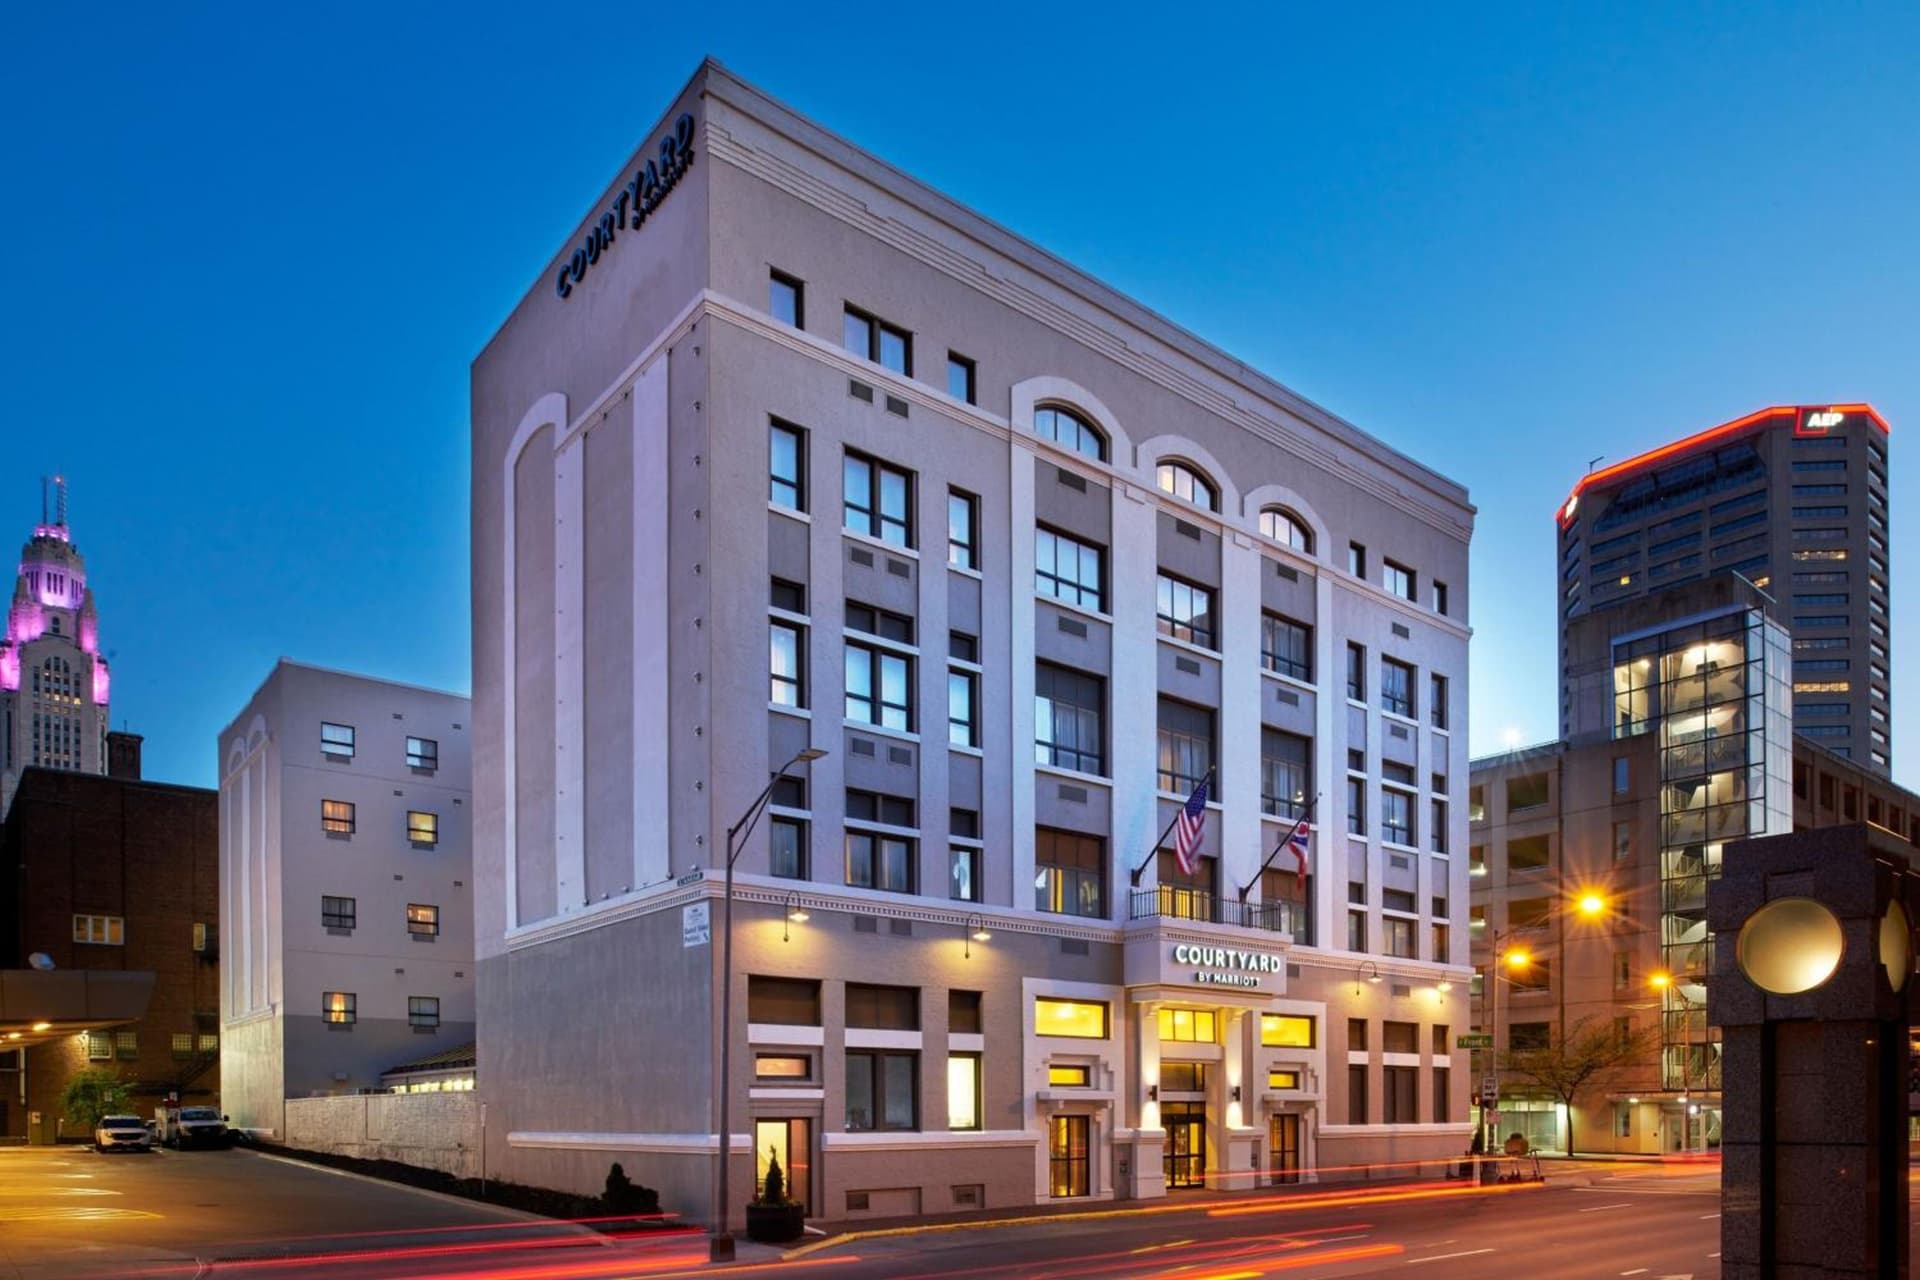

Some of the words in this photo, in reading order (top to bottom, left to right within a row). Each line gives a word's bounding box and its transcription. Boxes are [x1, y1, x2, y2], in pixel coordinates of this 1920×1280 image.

[557, 112, 695, 298] COURTYARD
[1807, 412, 1844, 427] AEP
[1175, 945, 1281, 973] COURTYARD
[1199, 971, 1210, 982] BY
[1214, 973, 1261, 987] MARRIOTT
